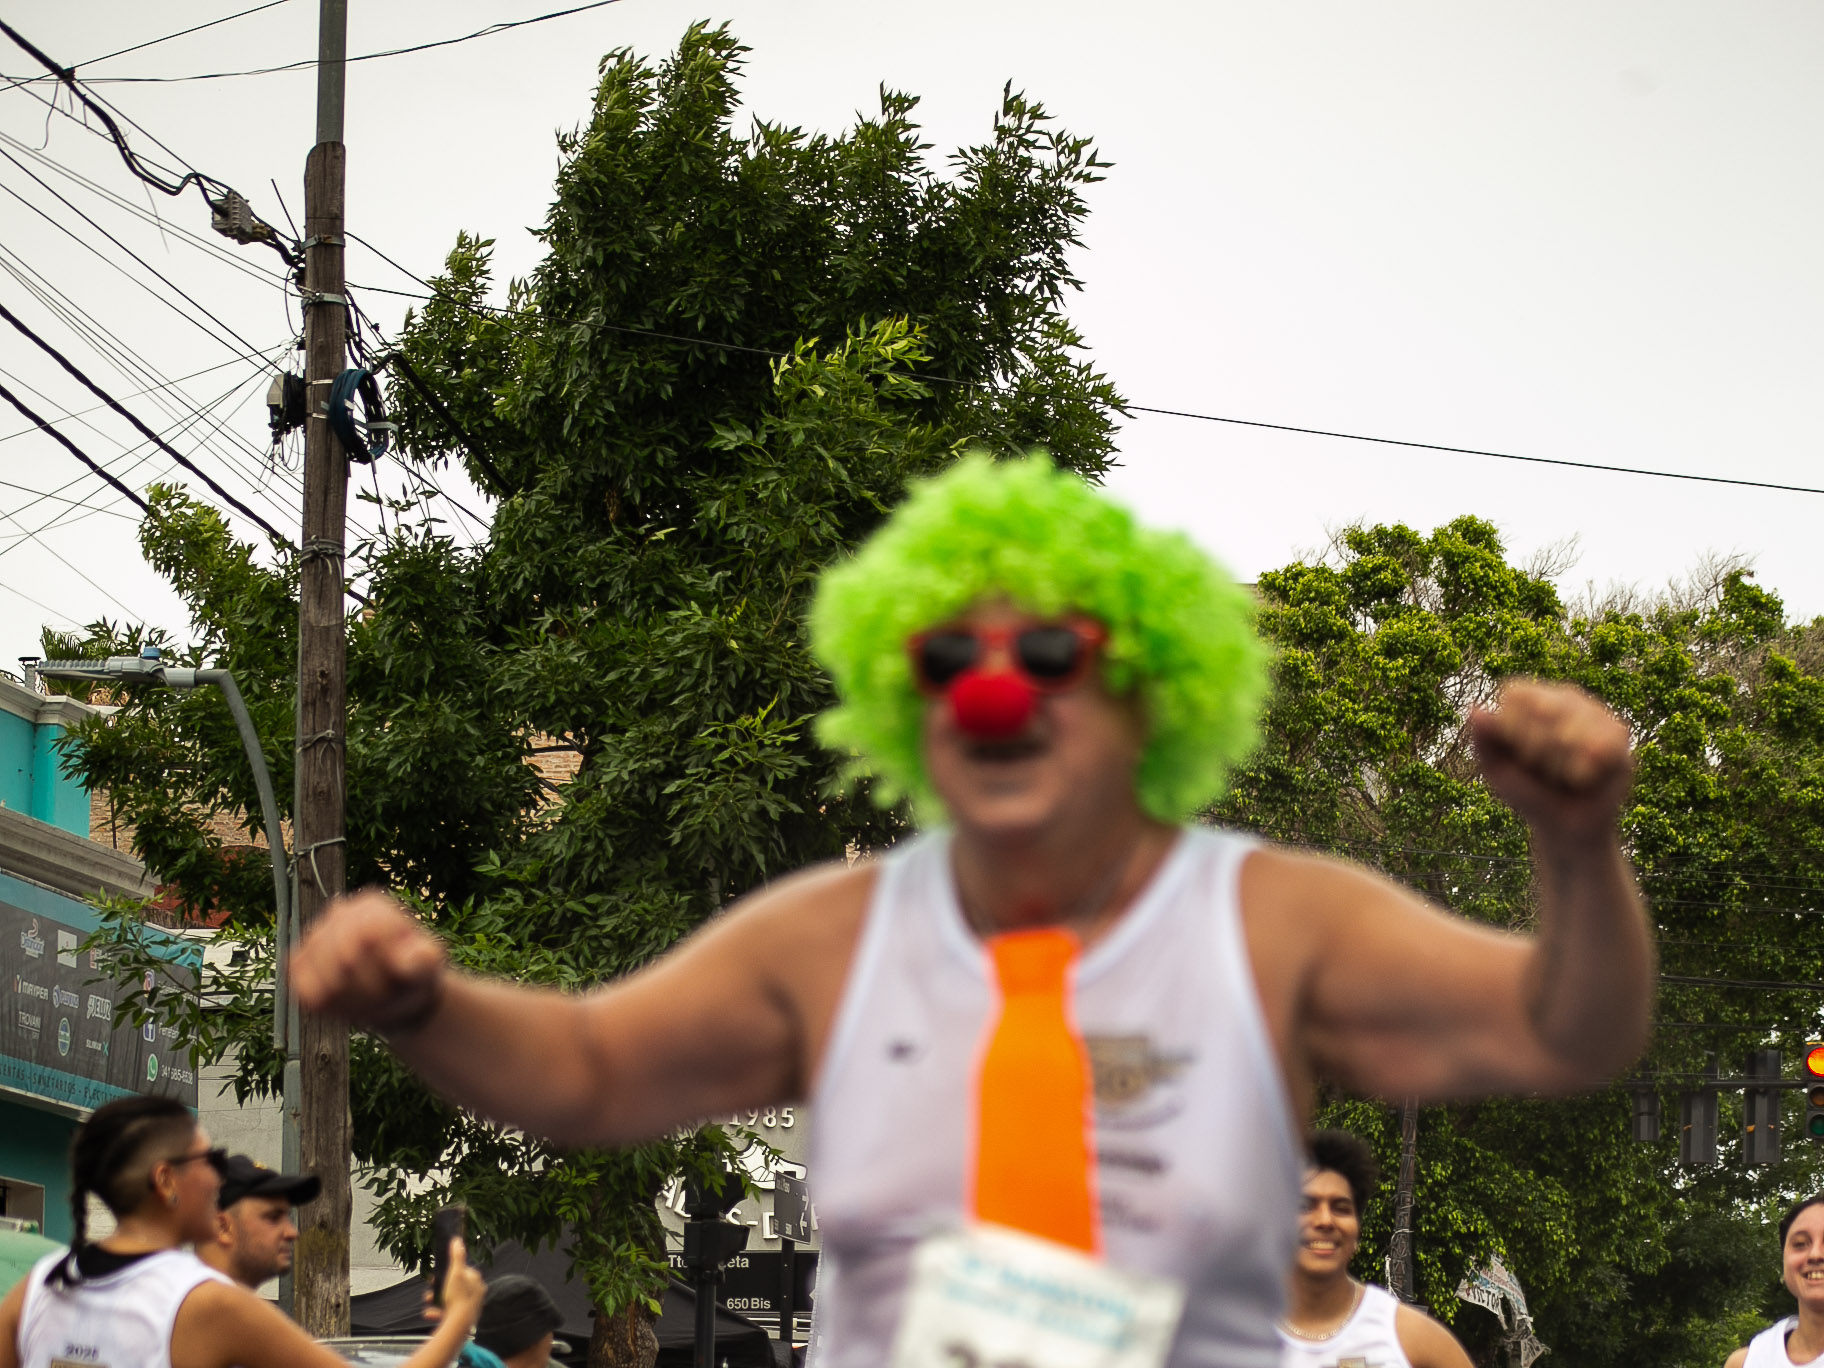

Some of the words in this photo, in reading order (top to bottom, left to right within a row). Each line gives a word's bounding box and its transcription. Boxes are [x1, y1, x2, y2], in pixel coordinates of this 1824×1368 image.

[0, 1063, 24, 1081] ENTAS
[728, 1106, 795, 1129] 1985
[726, 1298, 749, 1310] 650
[751, 1298, 771, 1310] Bis
